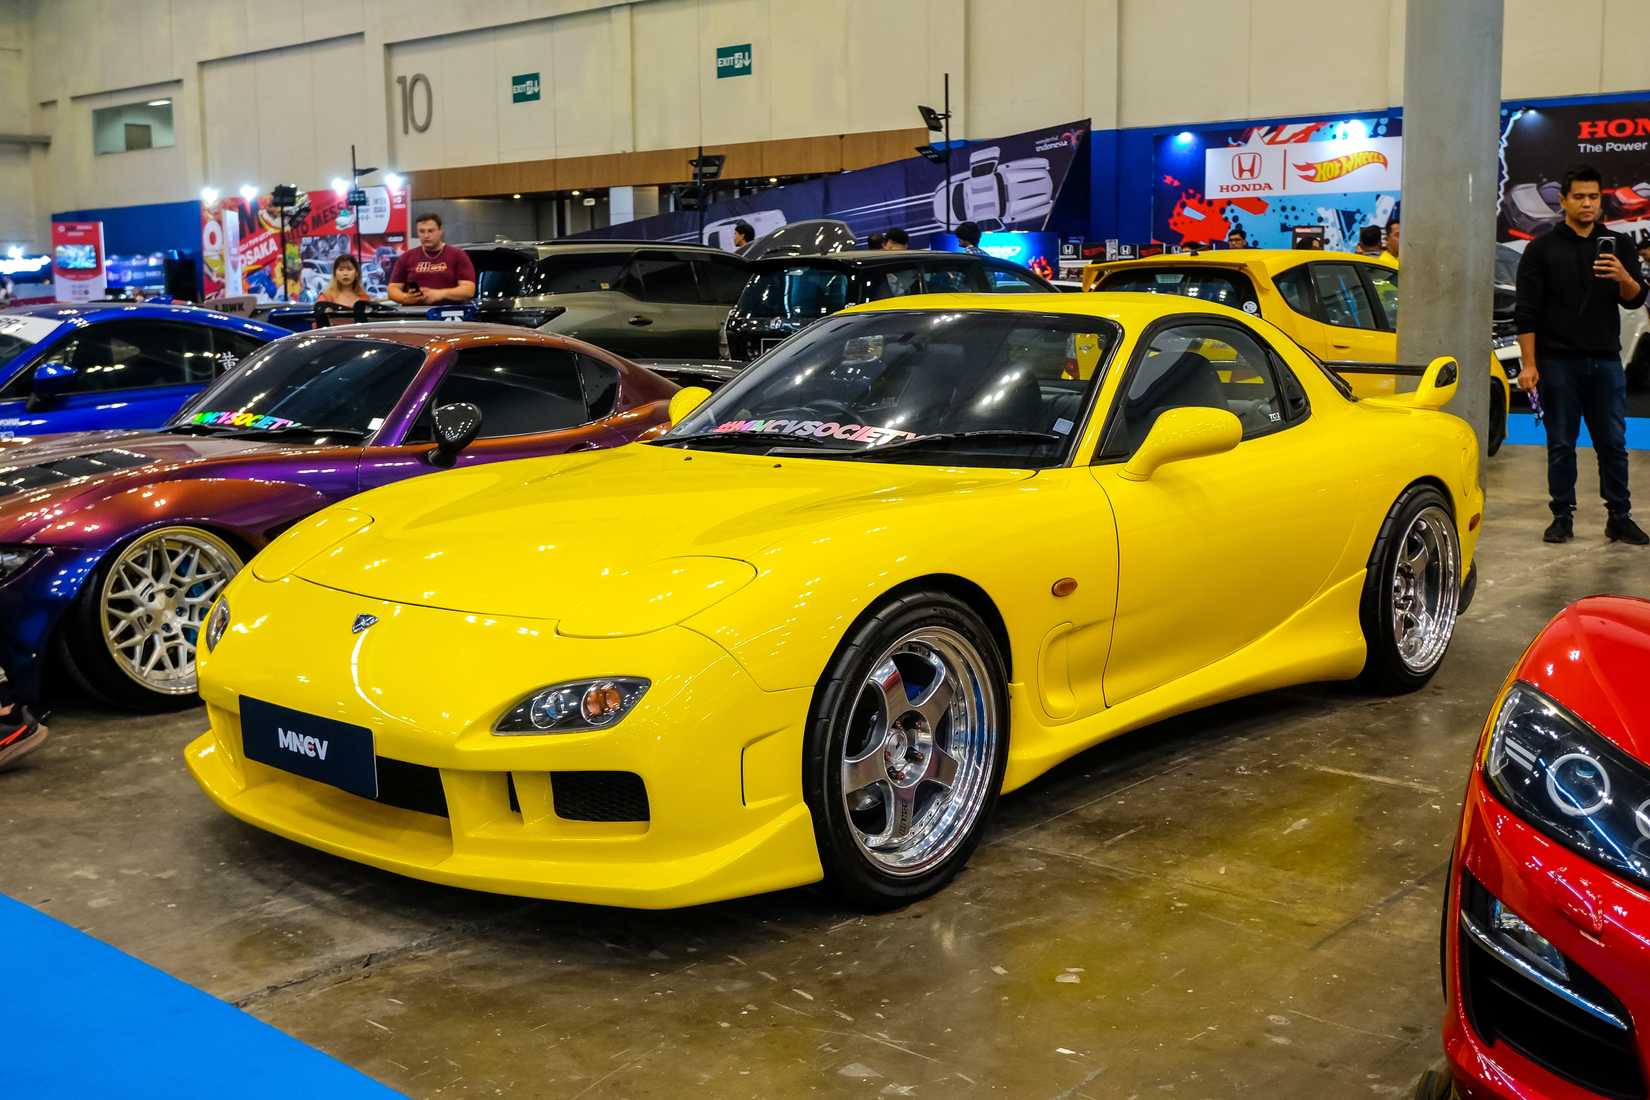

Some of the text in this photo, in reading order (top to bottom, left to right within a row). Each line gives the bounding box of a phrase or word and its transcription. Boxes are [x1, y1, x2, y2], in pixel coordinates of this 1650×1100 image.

[717, 57, 734, 67] EXIT
[396, 72, 433, 135] 10
[1577, 141, 1648, 153] The Power
[1219, 183, 1273, 192] HONDA
[277, 727, 329, 761] MNCV
